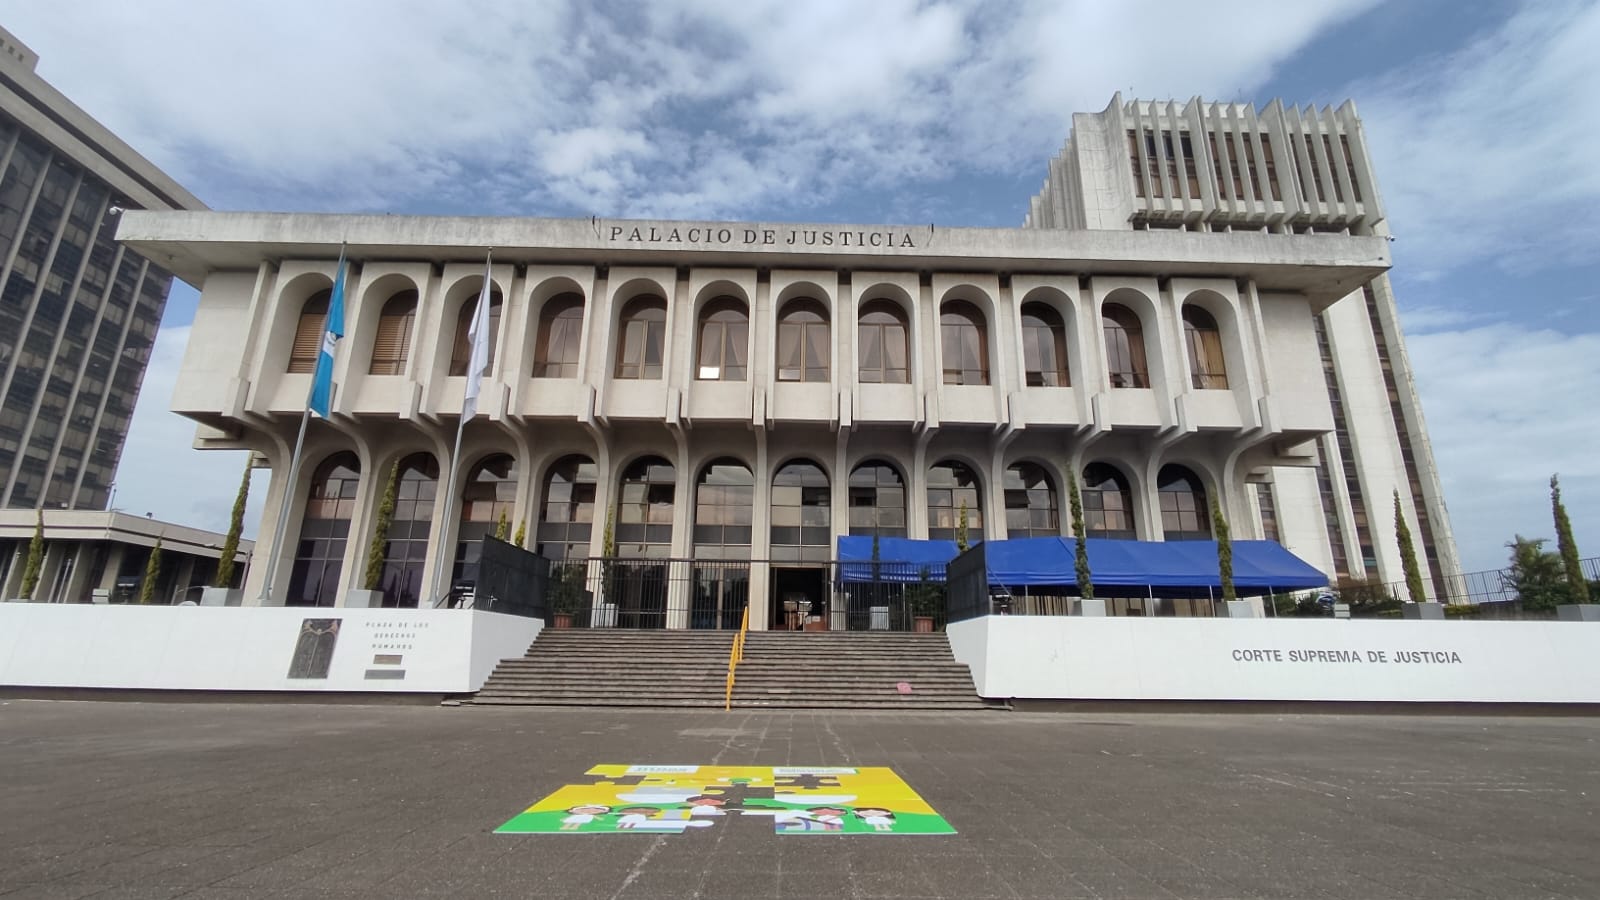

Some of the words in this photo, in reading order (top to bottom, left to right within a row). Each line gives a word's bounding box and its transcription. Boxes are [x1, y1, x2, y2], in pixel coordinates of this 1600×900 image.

[609, 226, 733, 244] PALACIO
[743, 229, 776, 245] DE
[786, 230, 916, 248] JUSTICIA
[398, 621, 408, 629] DE
[1232, 649, 1283, 662] CORTE
[1288, 650, 1362, 663] SUPREMA
[1367, 650, 1388, 663] DE
[1393, 651, 1463, 664] JUSTICIA
